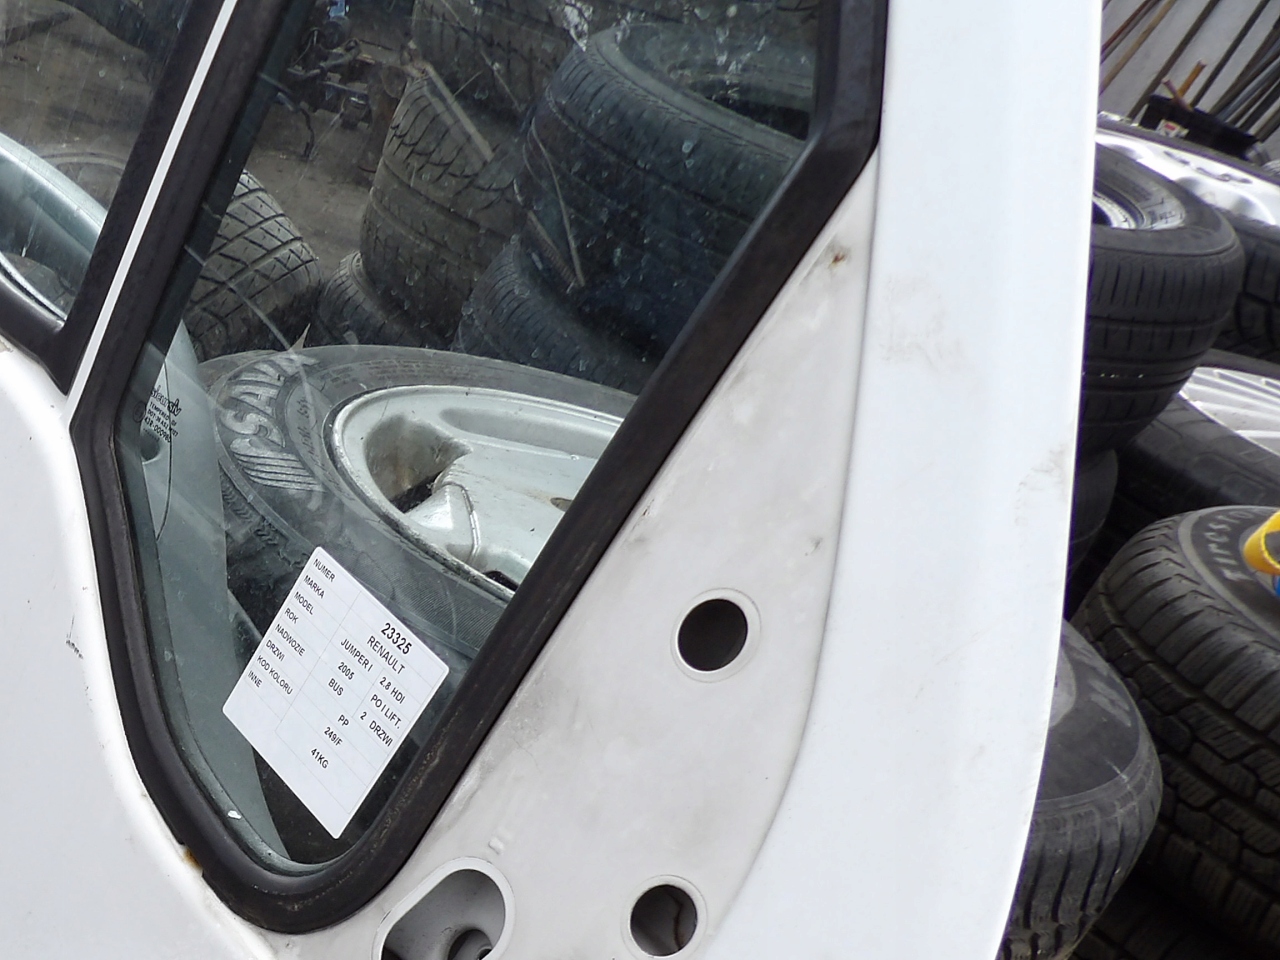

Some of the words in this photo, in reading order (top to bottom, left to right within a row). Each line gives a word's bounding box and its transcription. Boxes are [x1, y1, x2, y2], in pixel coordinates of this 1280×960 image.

[294, 591, 314, 615] MODEL
[340, 638, 370, 671] JUMPER
[379, 676, 391, 691] 2.8
[390, 687, 406, 705] HDI
[304, 575, 325, 599] MARKA
[366, 635, 406, 675] RENAULT
[313, 558, 336, 583] NUMER
[380, 622, 413, 655] 23325
[257, 655, 271, 671] KOD
[269, 668, 293, 695] KOLORU
[266, 639, 286, 662] DRZWI
[337, 714, 350, 727] PP
[275, 623, 306, 657] NADWOZIE
[328, 677, 344, 696] BUS
[359, 711, 367, 721] 2
[368, 720, 394, 747] DRZWI
[284, 608, 299, 624] ROK
[337, 661, 355, 680] 2005
[370, 693, 382, 708] PO
[384, 708, 402, 729] LIFT.
[248, 670, 263, 688] INNE
[311, 748, 330, 769] 41KG
